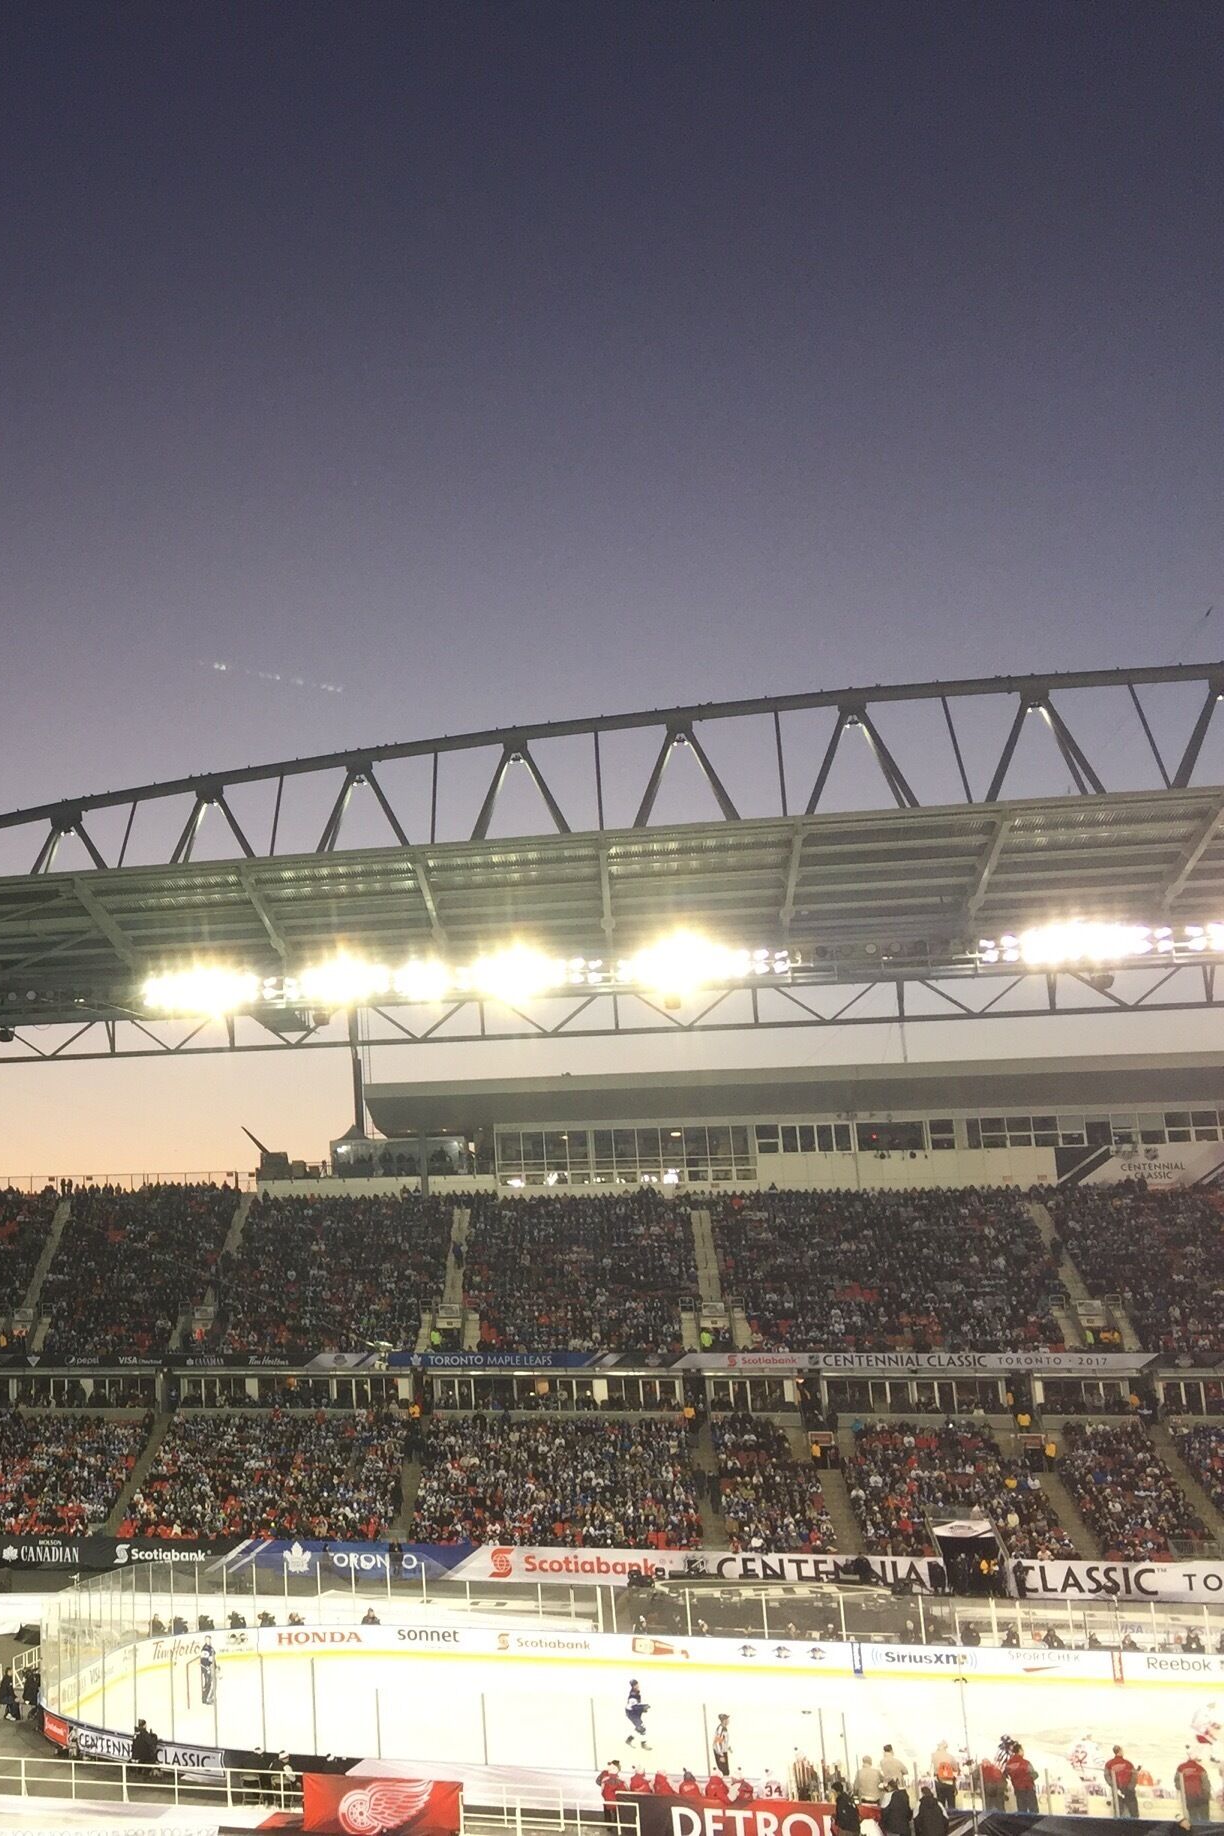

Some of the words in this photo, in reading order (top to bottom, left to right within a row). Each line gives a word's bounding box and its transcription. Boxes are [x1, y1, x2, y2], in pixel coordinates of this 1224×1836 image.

[1120, 1162, 1185, 1171] CENTENNIAL
[1134, 1171, 1173, 1179] CLASSIC
[118, 1356, 138, 1364] VISA
[429, 1355, 484, 1366] TORONTO
[487, 1356, 521, 1366] MAPLE
[524, 1356, 552, 1366] LEAFS
[741, 1357, 796, 1365] Scotiabank
[822, 1354, 923, 1368] CENTENNIAL
[927, 1354, 988, 1368] CLASSIC
[997, 1357, 1062, 1365] TORONTO
[1078, 1357, 1108, 1366] 2017
[21, 1546, 79, 1562] CANADIAN
[131, 1548, 206, 1562] Scotiabank
[330, 1552, 417, 1570] ORONO
[524, 1556, 656, 1576] Scotiabank
[277, 1631, 362, 1645] HONDA
[397, 1628, 460, 1643] sonnet
[516, 1637, 590, 1651] Scotiabank
[1146, 1657, 1213, 1671] Reebok
[79, 1733, 132, 1758] CENTENN
[156, 1749, 212, 1768] CLASSIC
